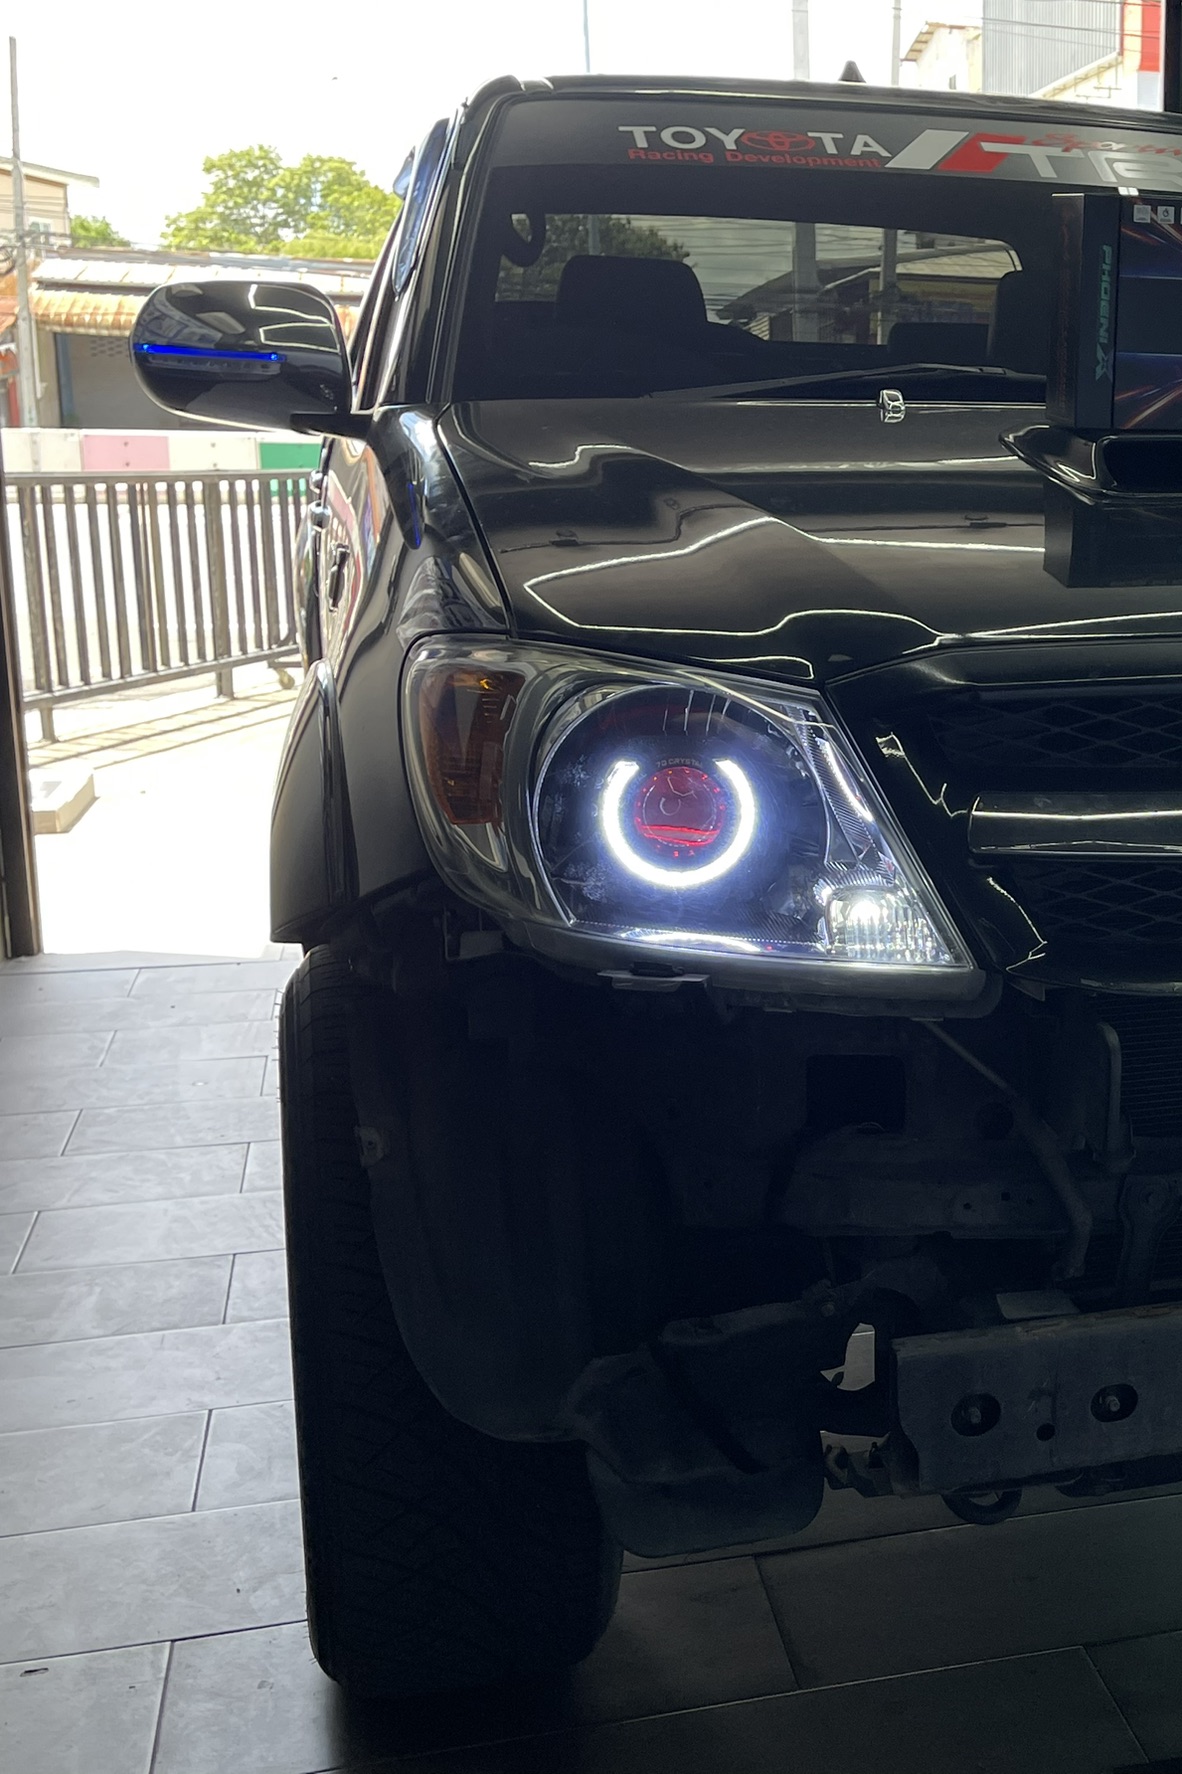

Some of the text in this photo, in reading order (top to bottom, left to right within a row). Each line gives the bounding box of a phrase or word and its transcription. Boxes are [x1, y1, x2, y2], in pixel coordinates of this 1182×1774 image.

[628, 149, 880, 168] Racing Development
[1095, 245, 1113, 382] PHOENIX
